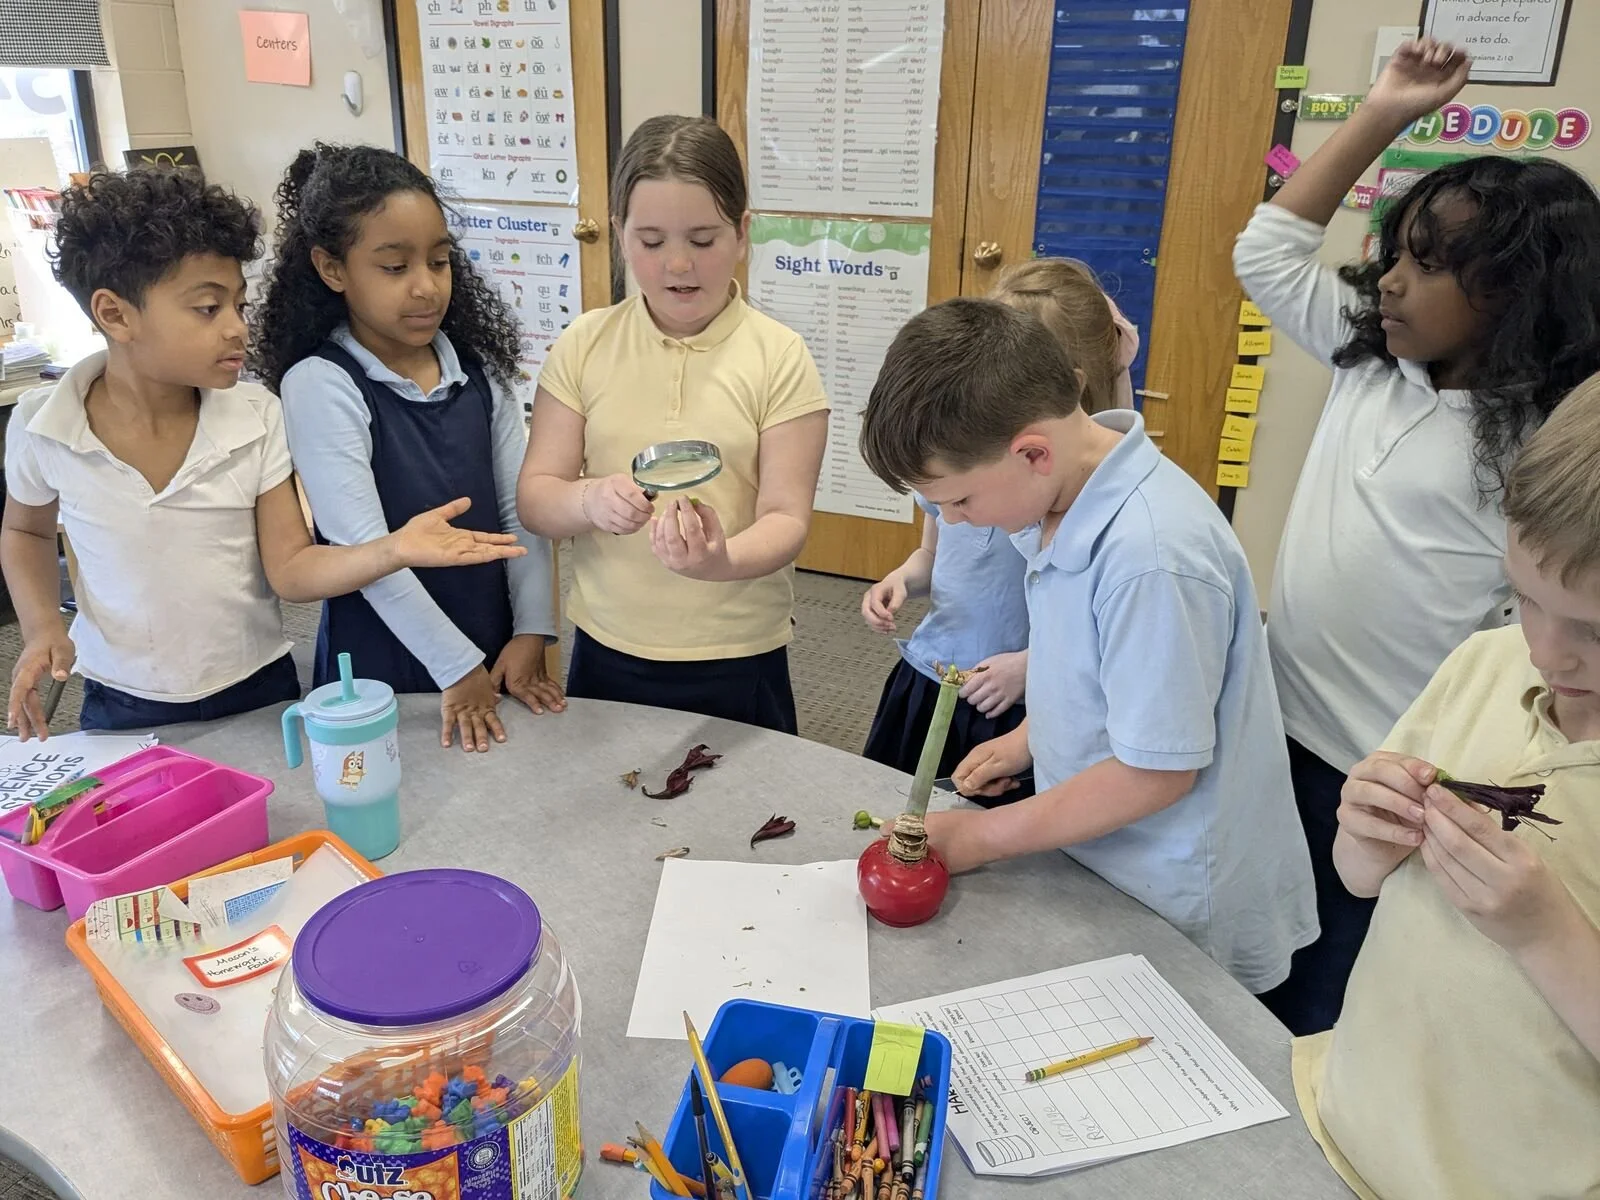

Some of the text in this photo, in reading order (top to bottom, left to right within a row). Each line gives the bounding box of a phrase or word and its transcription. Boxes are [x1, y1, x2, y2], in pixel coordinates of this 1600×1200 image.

[1456, 11, 1531, 22] in advance for
[256, 36, 297, 51] Centers
[1465, 33, 1511, 44] us to do.
[1311, 103, 1346, 112] BOYS
[1414, 112, 1578, 141] HEDULE
[450, 214, 492, 228] Letter
[497, 217, 548, 232] Cluster
[775, 255, 821, 275] Sight
[828, 259, 883, 276] Words
[0, 753, 60, 802] IENCE
[206, 956, 260, 976] Homework
[216, 947, 259, 966] Mason's
[248, 952, 281, 971] Folder
